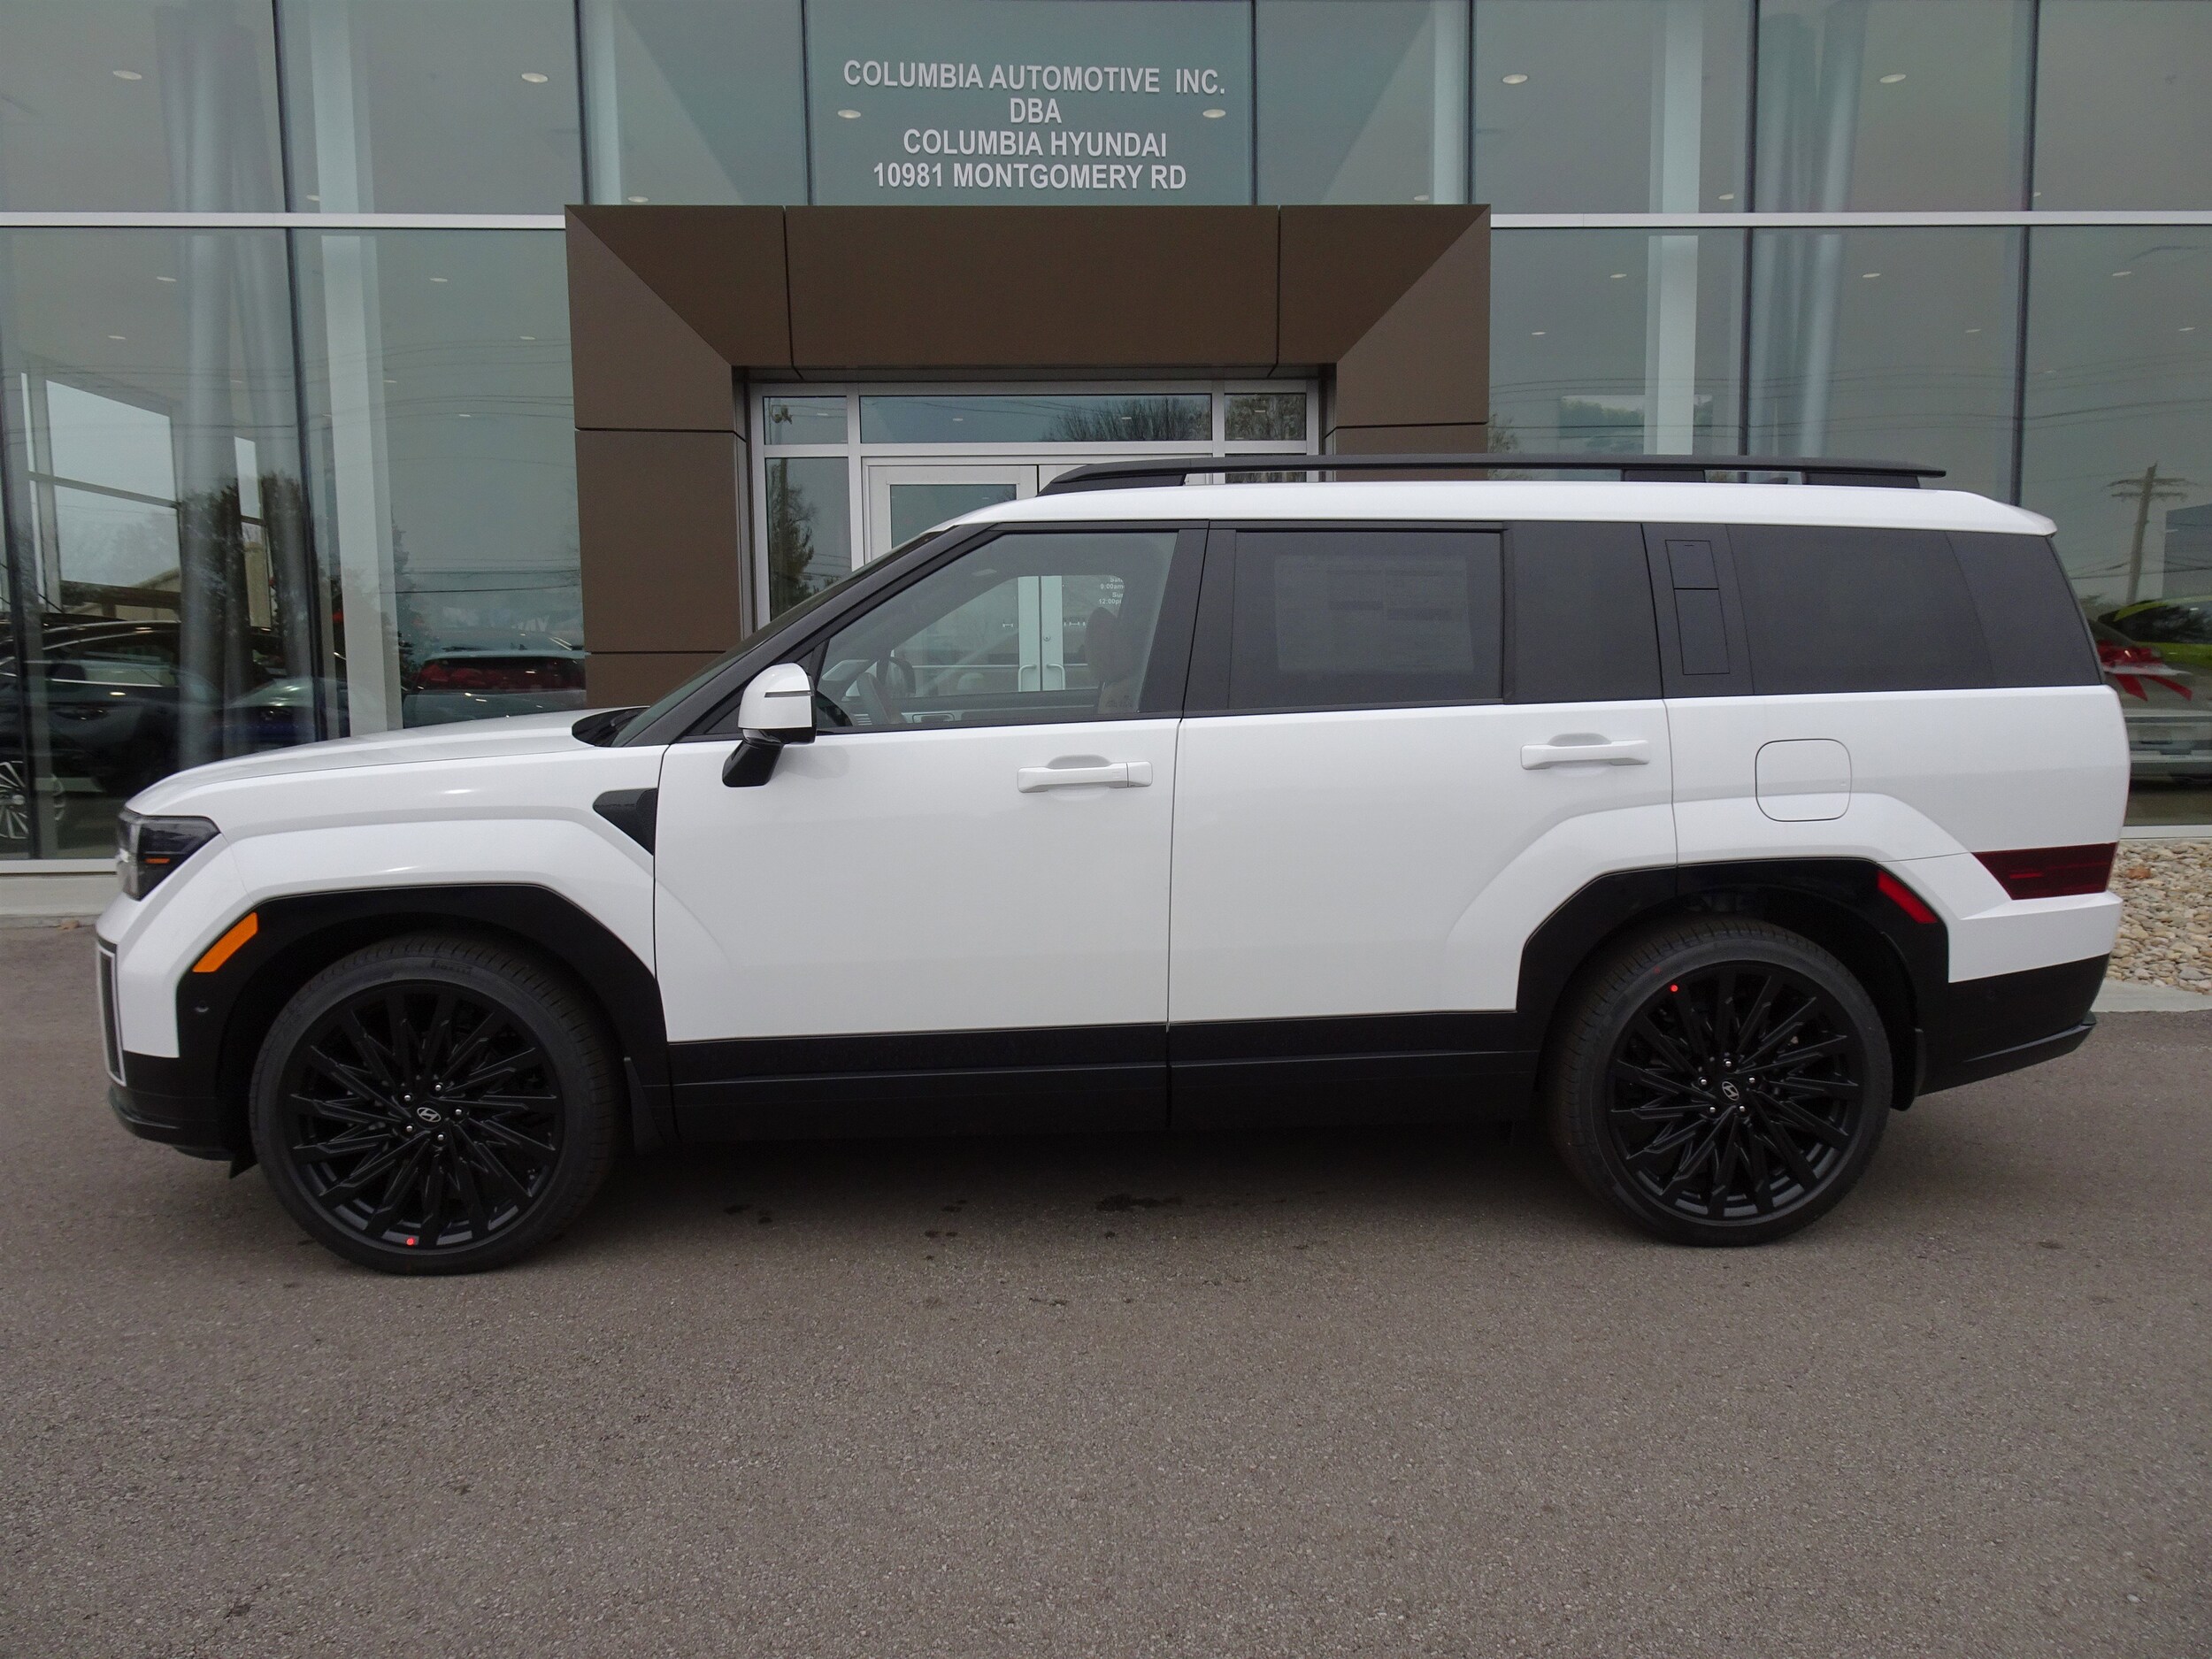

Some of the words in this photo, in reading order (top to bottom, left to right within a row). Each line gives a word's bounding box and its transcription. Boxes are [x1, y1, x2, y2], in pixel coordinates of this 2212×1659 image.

[843, 59, 984, 88] COLUMBIA
[988, 64, 1160, 93] AUTOMOTIVE
[1176, 68, 1226, 95] INC.
[1010, 97, 1063, 124] DBA
[903, 128, 1044, 156] COLUMBIA
[1050, 131, 1167, 157] HYUNDAI
[873, 162, 943, 188] 10981
[953, 162, 1143, 189] MONTGOMERY
[1151, 165, 1187, 189] RD
